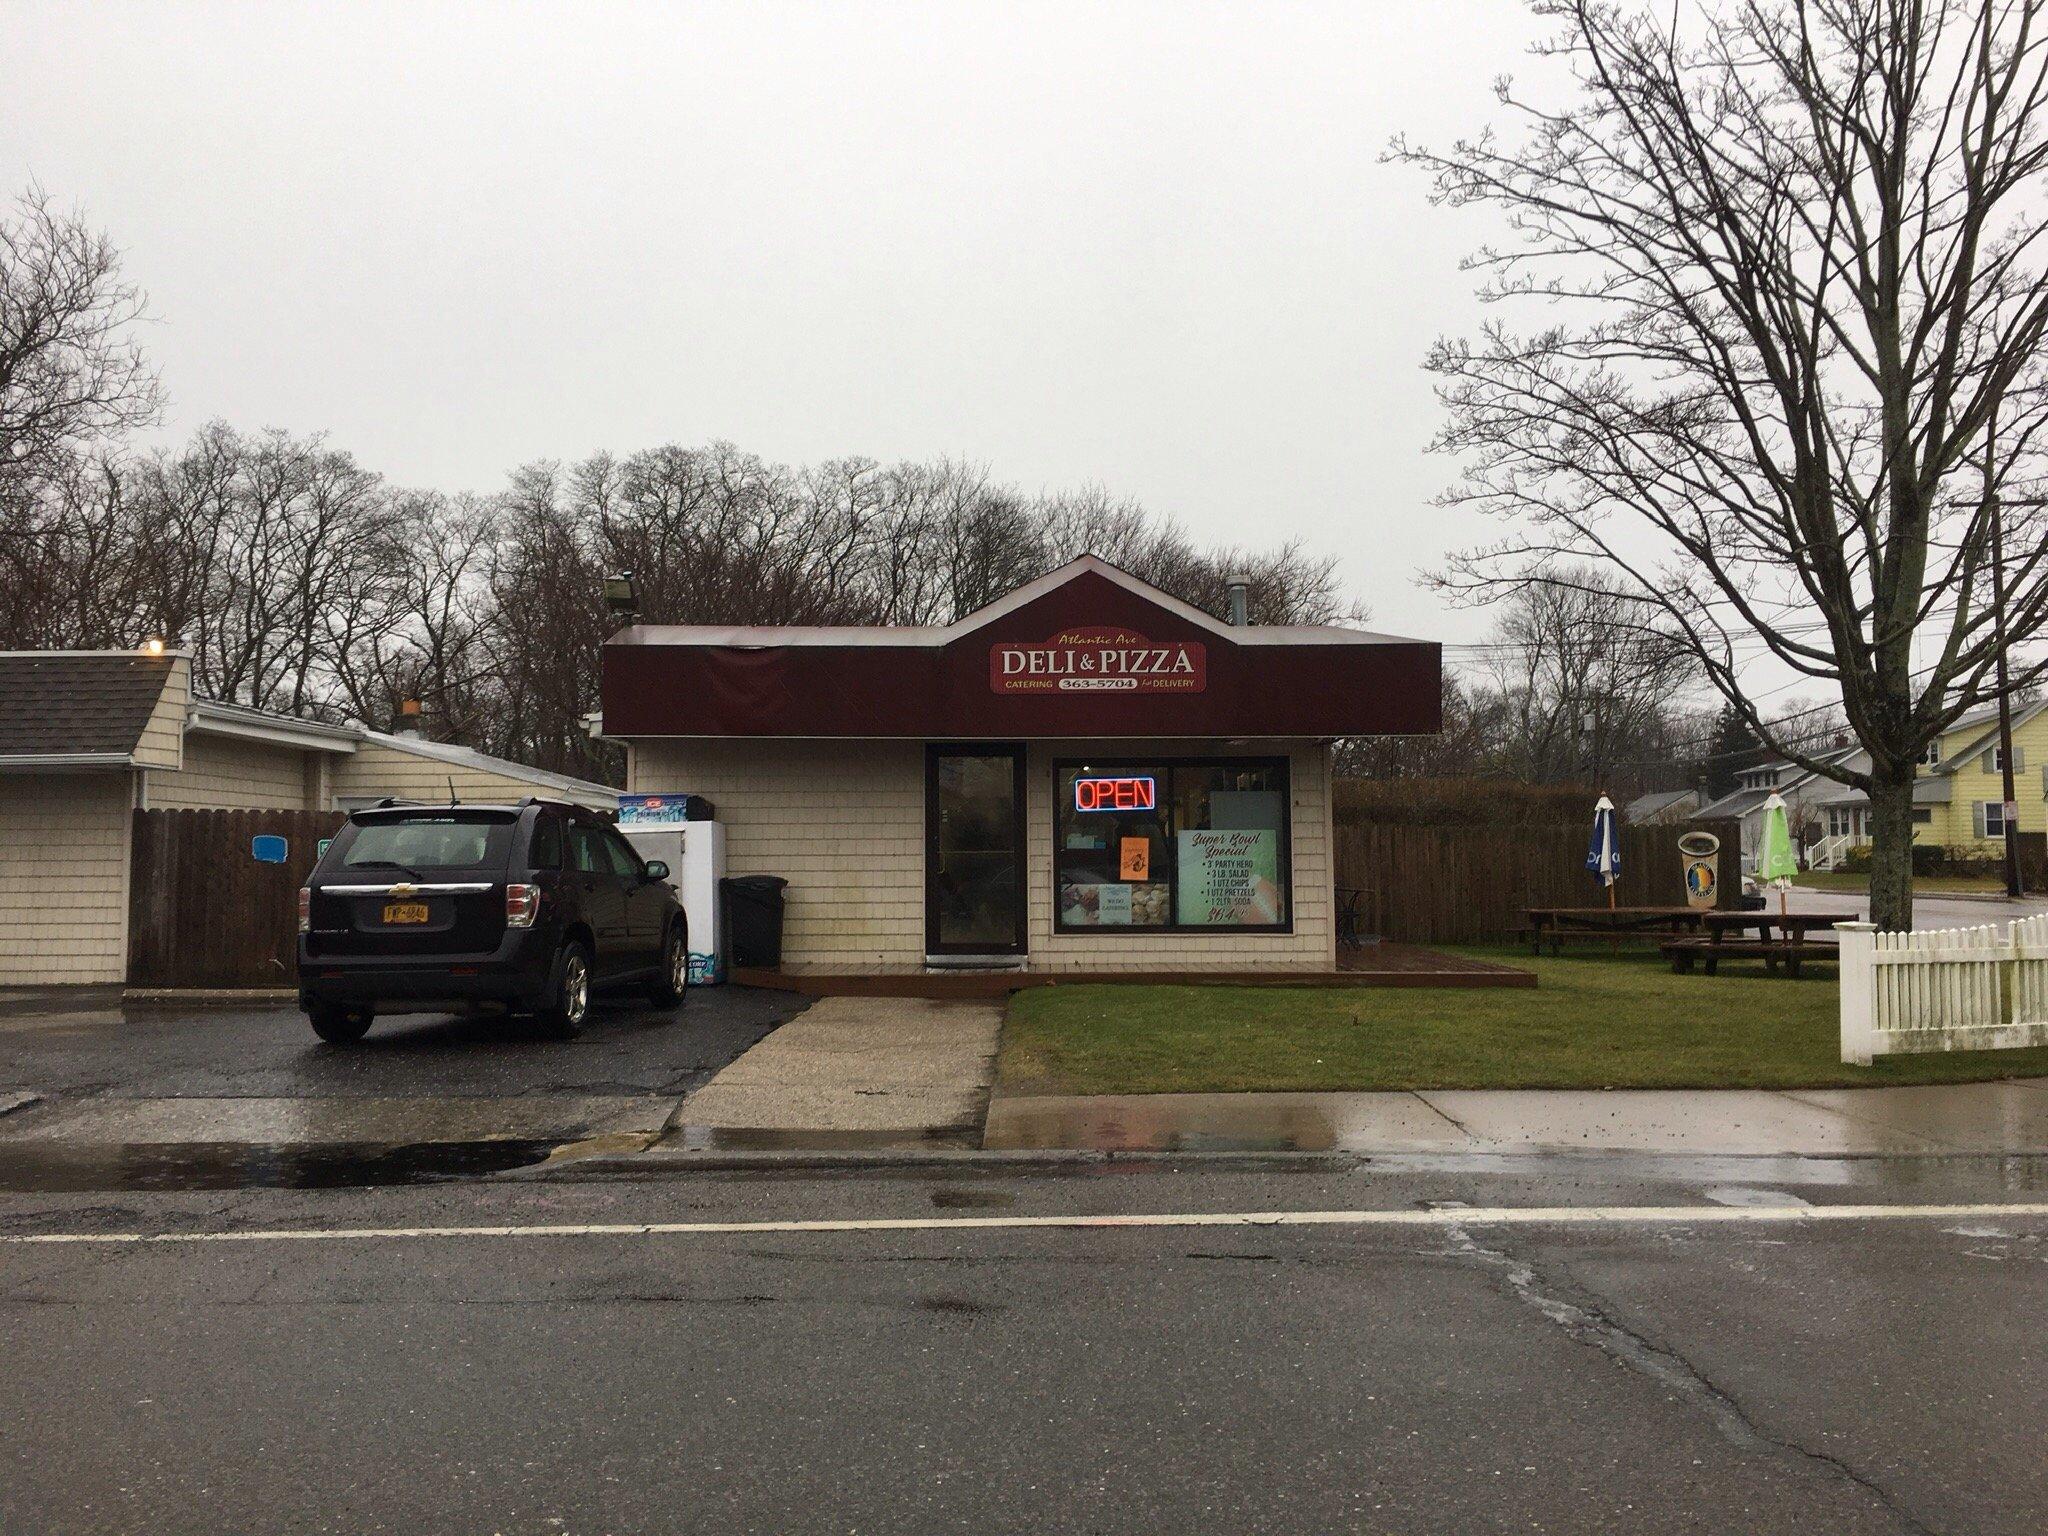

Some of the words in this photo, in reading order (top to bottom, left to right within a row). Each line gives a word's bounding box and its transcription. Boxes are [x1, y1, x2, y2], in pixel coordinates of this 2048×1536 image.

[1058, 634, 1111, 645] Atlantic
[1115, 634, 1137, 645] Ave
[1001, 650, 1076, 674] DELI
[1080, 653, 1095, 671] &
[1098, 649, 1195, 674] PIZZA
[1005, 680, 1053, 689] CATERING
[1061, 679, 1135, 689] 363-5704
[1152, 678, 1195, 688] DELIVERY
[1077, 780, 1153, 810] OPEN
[1192, 832, 1225, 847] Super
[1229, 831, 1262, 847] Bowl
[1205, 845, 1249, 859] Special
[1215, 860, 1236, 868] PARTY
[1236, 860, 1254, 868] HERO
[1228, 869, 1249, 878] SALAD
[1217, 879, 1230, 887] UTZ
[1230, 879, 1250, 887] CHIPS
[1211, 888, 1224, 896] UTZ
[1224, 888, 1256, 897] PRETZELS
